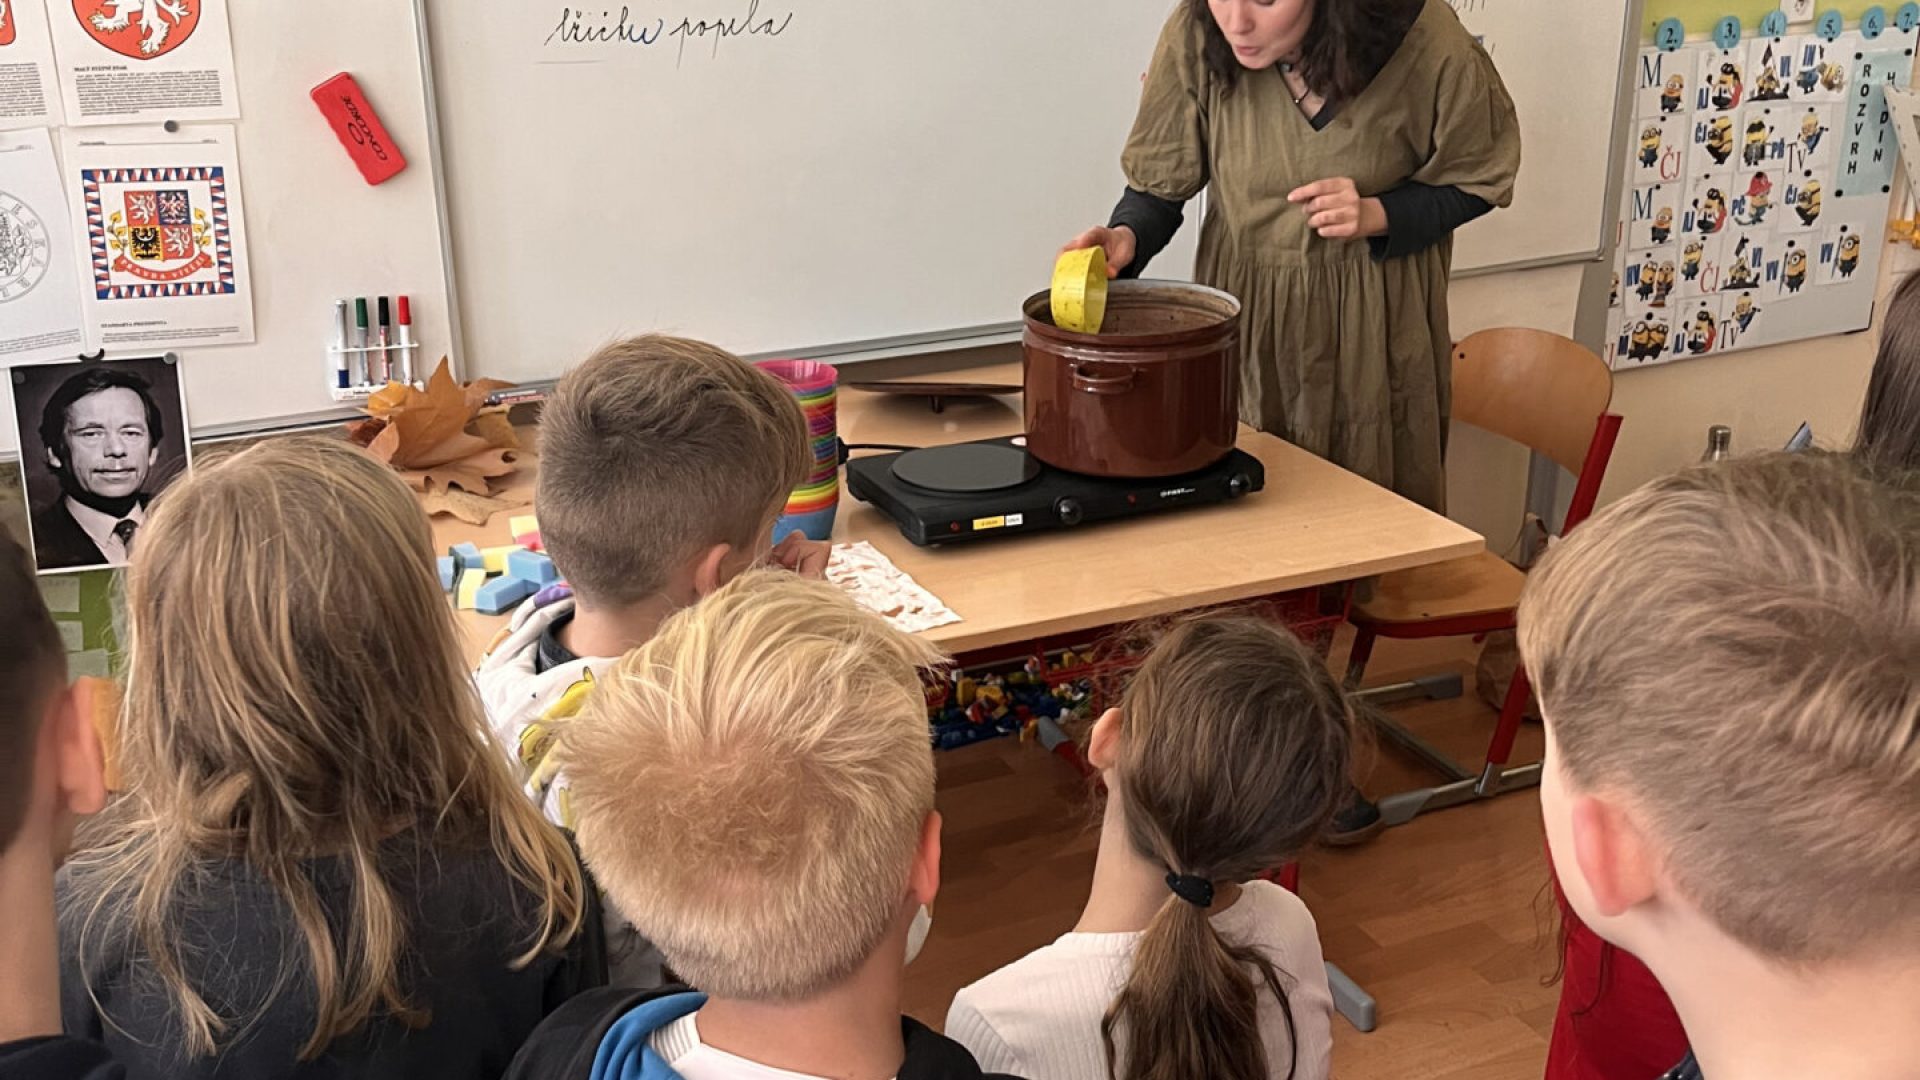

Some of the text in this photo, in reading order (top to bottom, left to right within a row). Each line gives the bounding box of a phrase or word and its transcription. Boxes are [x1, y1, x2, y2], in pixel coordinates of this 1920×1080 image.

[1666, 27, 1678, 45] 2.
[1724, 22, 1737, 39] 3.
[1824, 20, 1836, 36] 5.
[1868, 17, 1878, 30] 6.
[1641, 53, 1663, 88] M
[341, 95, 388, 161] CONCORDE
[1872, 71, 1897, 163] HDIN
[1660, 144, 1681, 180] ČJ
[1787, 141, 1806, 174] TV
[1632, 187, 1653, 221] M
[1700, 260, 1720, 293] ČJ
[1720, 319, 1739, 348] TV
